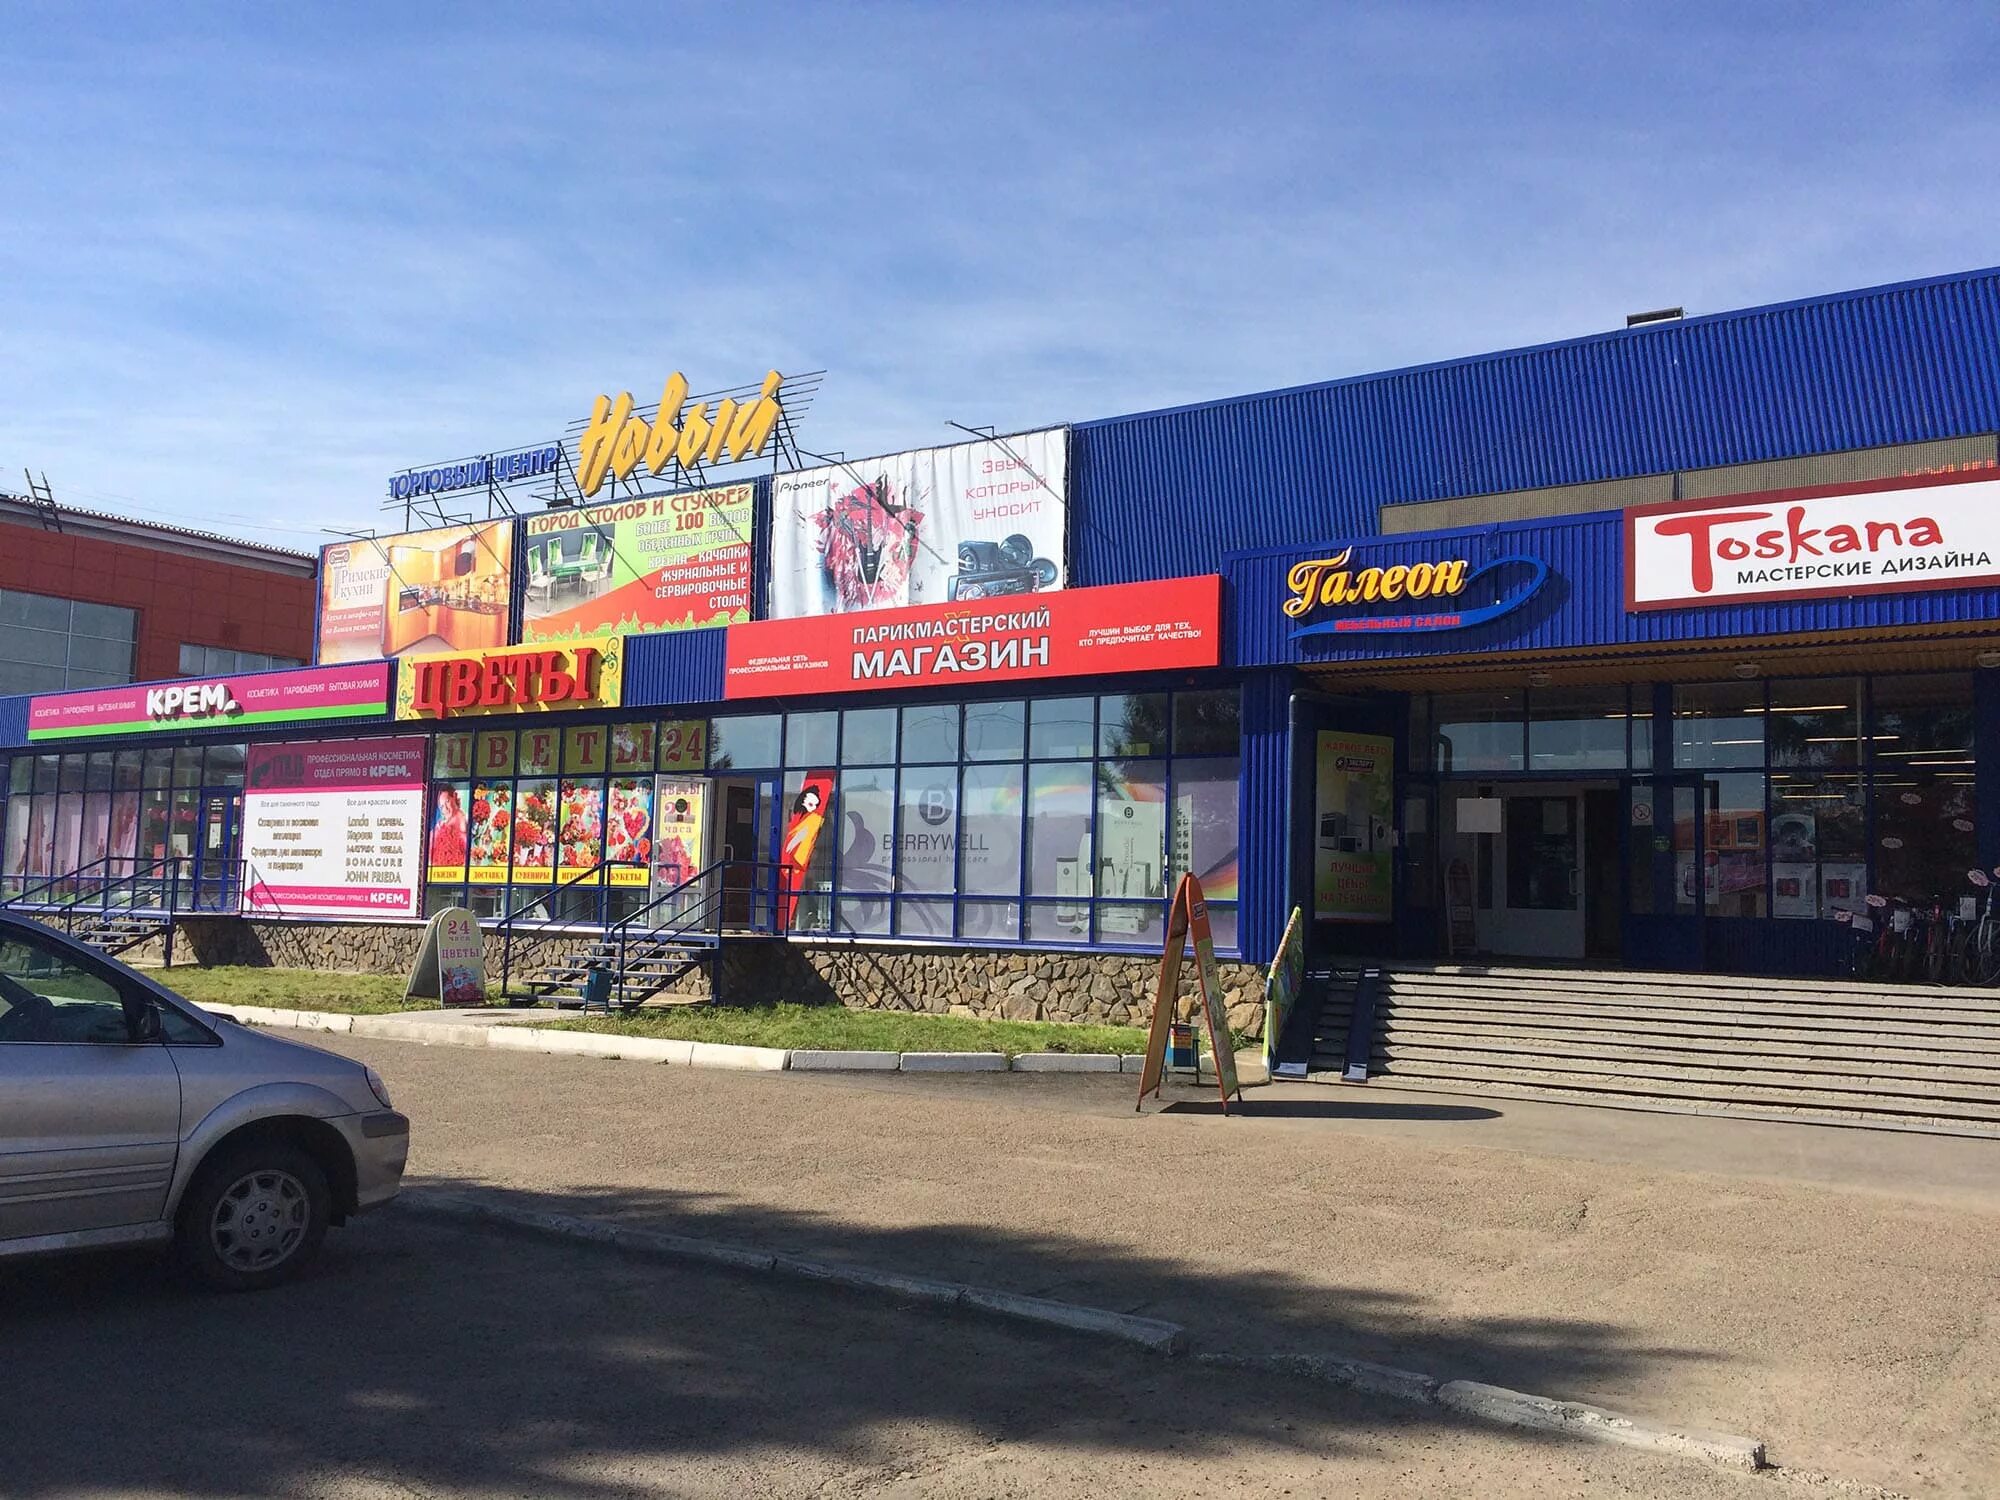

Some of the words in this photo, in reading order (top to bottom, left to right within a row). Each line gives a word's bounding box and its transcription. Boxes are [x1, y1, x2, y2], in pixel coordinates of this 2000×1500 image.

[576, 369, 784, 497] Новый
[388, 455, 488, 498] ТОРГОВЫЙ
[495, 447, 559, 481] ЦЕНТР
[780, 478, 830, 493] Pioneer
[531, 512, 579, 534] ГОРОД
[586, 501, 646, 524] СТОЛОВ
[653, 499, 664, 516] И
[636, 519, 670, 536] БОЛЕЕ
[675, 512, 704, 531] 100
[648, 553, 687, 569] КРЕСЛА
[698, 546, 748, 562] КАЧАЛКИ
[1654, 506, 1943, 593] Toskana
[661, 562, 737, 583] ЖУРНАЛЬНЫЕ
[740, 561, 748, 573] И
[1737, 561, 1872, 584] МАСТЕРСКИЕ
[1881, 551, 1991, 575] ДИЗАЙНА
[655, 578, 747, 599] СЕРВИРОВОЧНЫЕ
[1283, 545, 1468, 617] Галеон
[709, 594, 748, 609] СТОЛЫ
[853, 605, 1050, 645] ПАРИКМАСТЕРСКИЙ
[1123, 624, 1152, 634] ВЫБОР
[1155, 623, 1171, 632] ДЛЯ
[1079, 638, 1093, 647] КТО
[1096, 633, 1155, 646] ПРЕДПОЧИТАЕТ
[792, 654, 808, 662] СЕТЬ
[852, 636, 1050, 679] МАГАЗИН
[247, 687, 279, 699] КОСМЕТИКА
[284, 683, 325, 695] ПАРФЮМЕРИЯ
[410, 648, 597, 720] ЦВЕТЫ
[665, 727, 702, 762] 24
[307, 754, 377, 764] ПРОФЕССИОНАЛЬНАЯ
[378, 751, 421, 761] КОСМЕТИКА
[362, 767, 368, 776] В
[345, 871, 369, 882] JOHN
[448, 920, 470, 935] 24
[442, 948, 480, 959] ЦВЕТЫ
